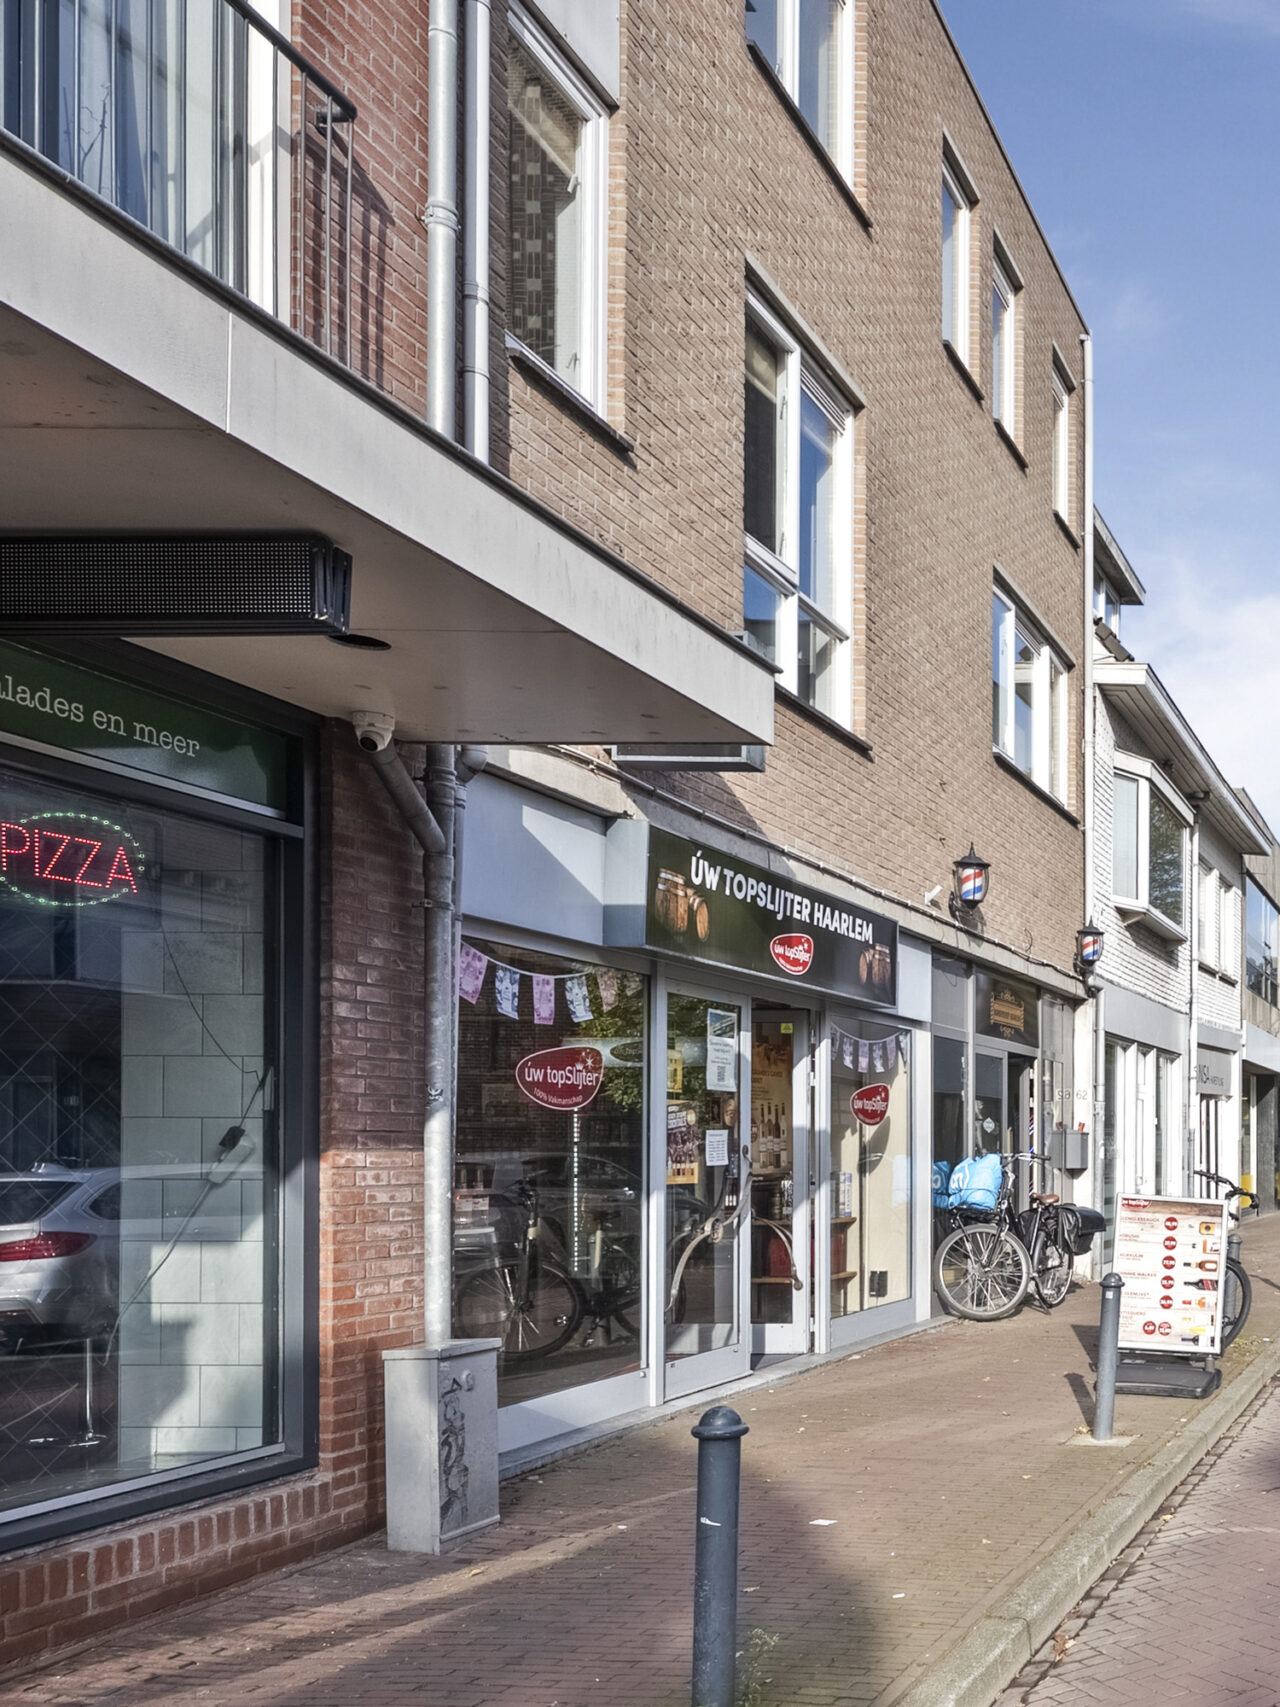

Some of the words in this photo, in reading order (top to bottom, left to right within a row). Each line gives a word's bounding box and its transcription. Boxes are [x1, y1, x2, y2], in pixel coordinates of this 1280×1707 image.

[93, 709, 126, 737] en
[133, 722, 200, 758] meer
[1, 822, 138, 894] PIZZA
[690, 850, 721, 892] ÚW
[723, 868, 811, 923] TOPSLIJTER
[813, 902, 873, 945] HAARLEM
[524, 1061, 544, 1083] úw
[546, 1066, 599, 1090] topSlijter
[533, 1087, 548, 1101] 100%
[1076, 1090, 1088, 1100] 62
